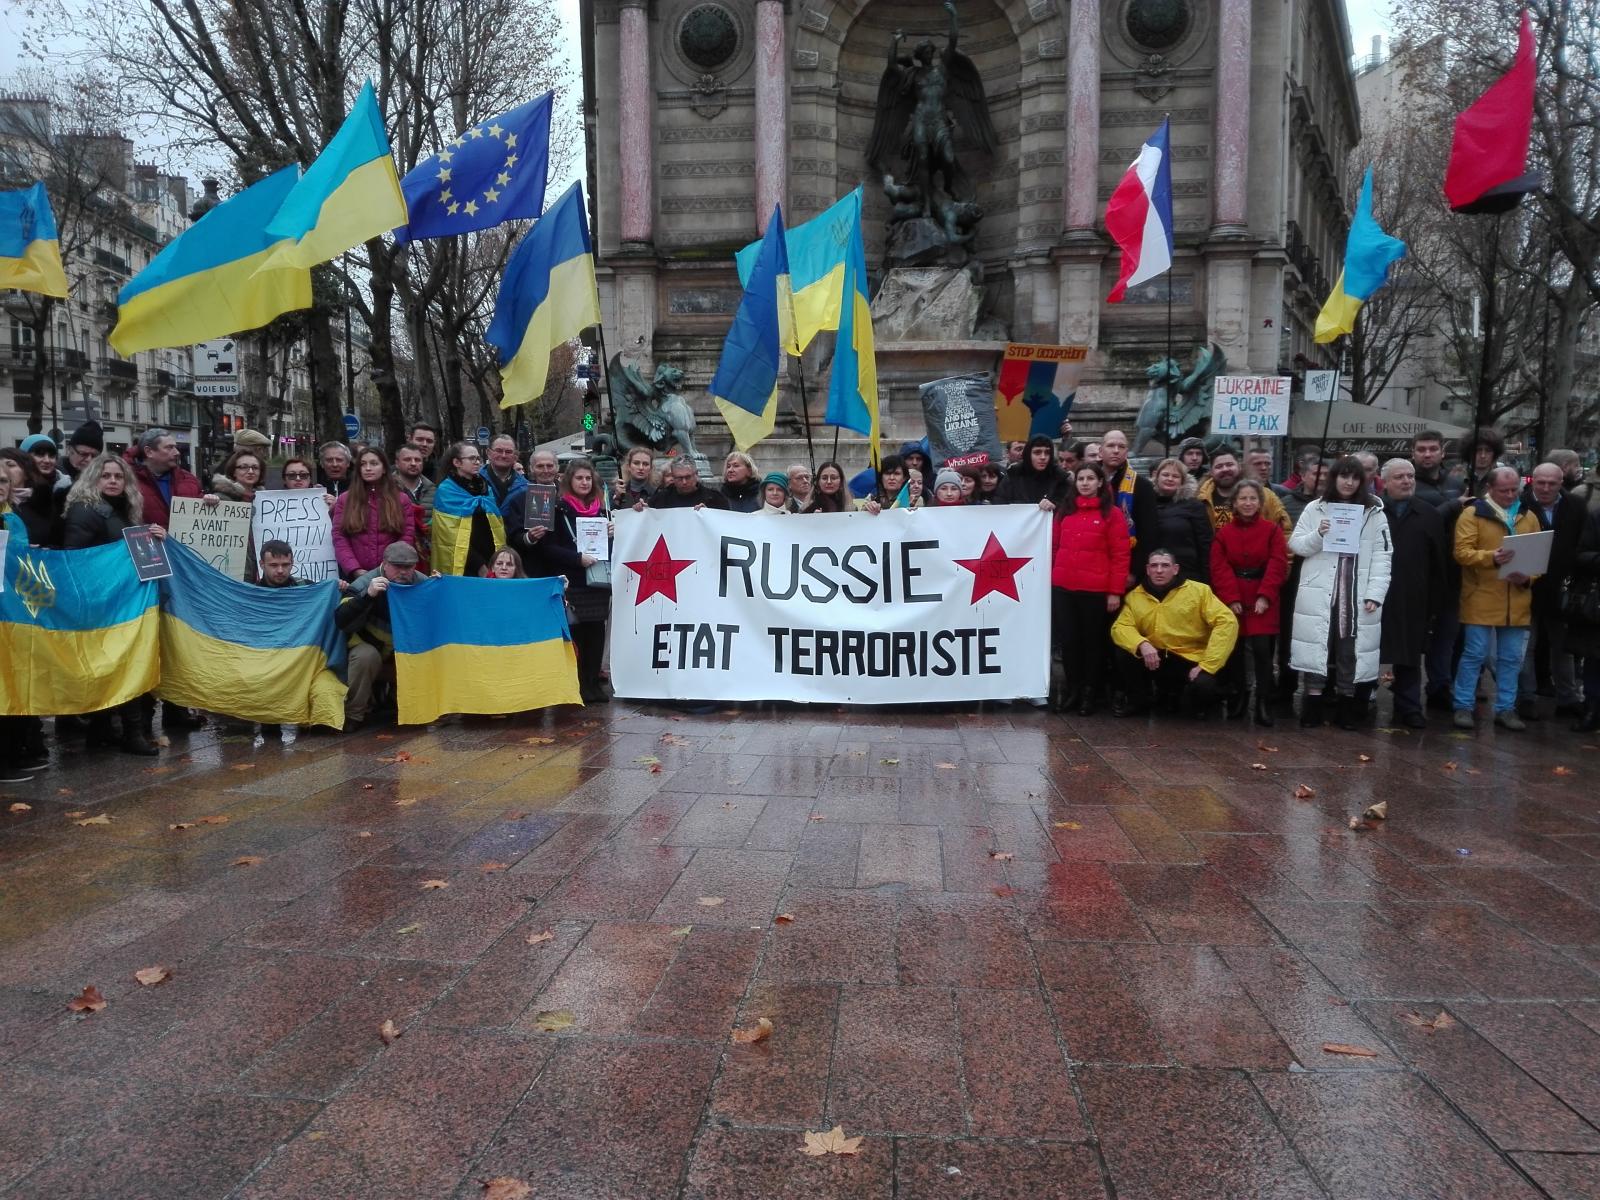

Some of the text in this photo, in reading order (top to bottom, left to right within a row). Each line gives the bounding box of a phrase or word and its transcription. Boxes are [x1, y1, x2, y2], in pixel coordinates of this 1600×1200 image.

[1008, 346, 1035, 358] STOP
[196, 385, 237, 393] VOIE BUS
[1217, 378, 1285, 395] L'UKRAINE
[1230, 397, 1267, 412] POUR
[944, 417, 979, 431] UKRAINE
[945, 415, 960, 423] AND
[1219, 414, 1280, 430] LA PAIX
[172, 501, 250, 519] LA PAIX PASSE
[260, 496, 321, 523] PRESS
[192, 519, 229, 532] AVANT
[201, 533, 245, 548] PROFITS
[262, 523, 326, 546] PUTIN
[718, 535, 943, 603] RUSSIE
[652, 623, 1001, 677] ETAT TERRORISTE
